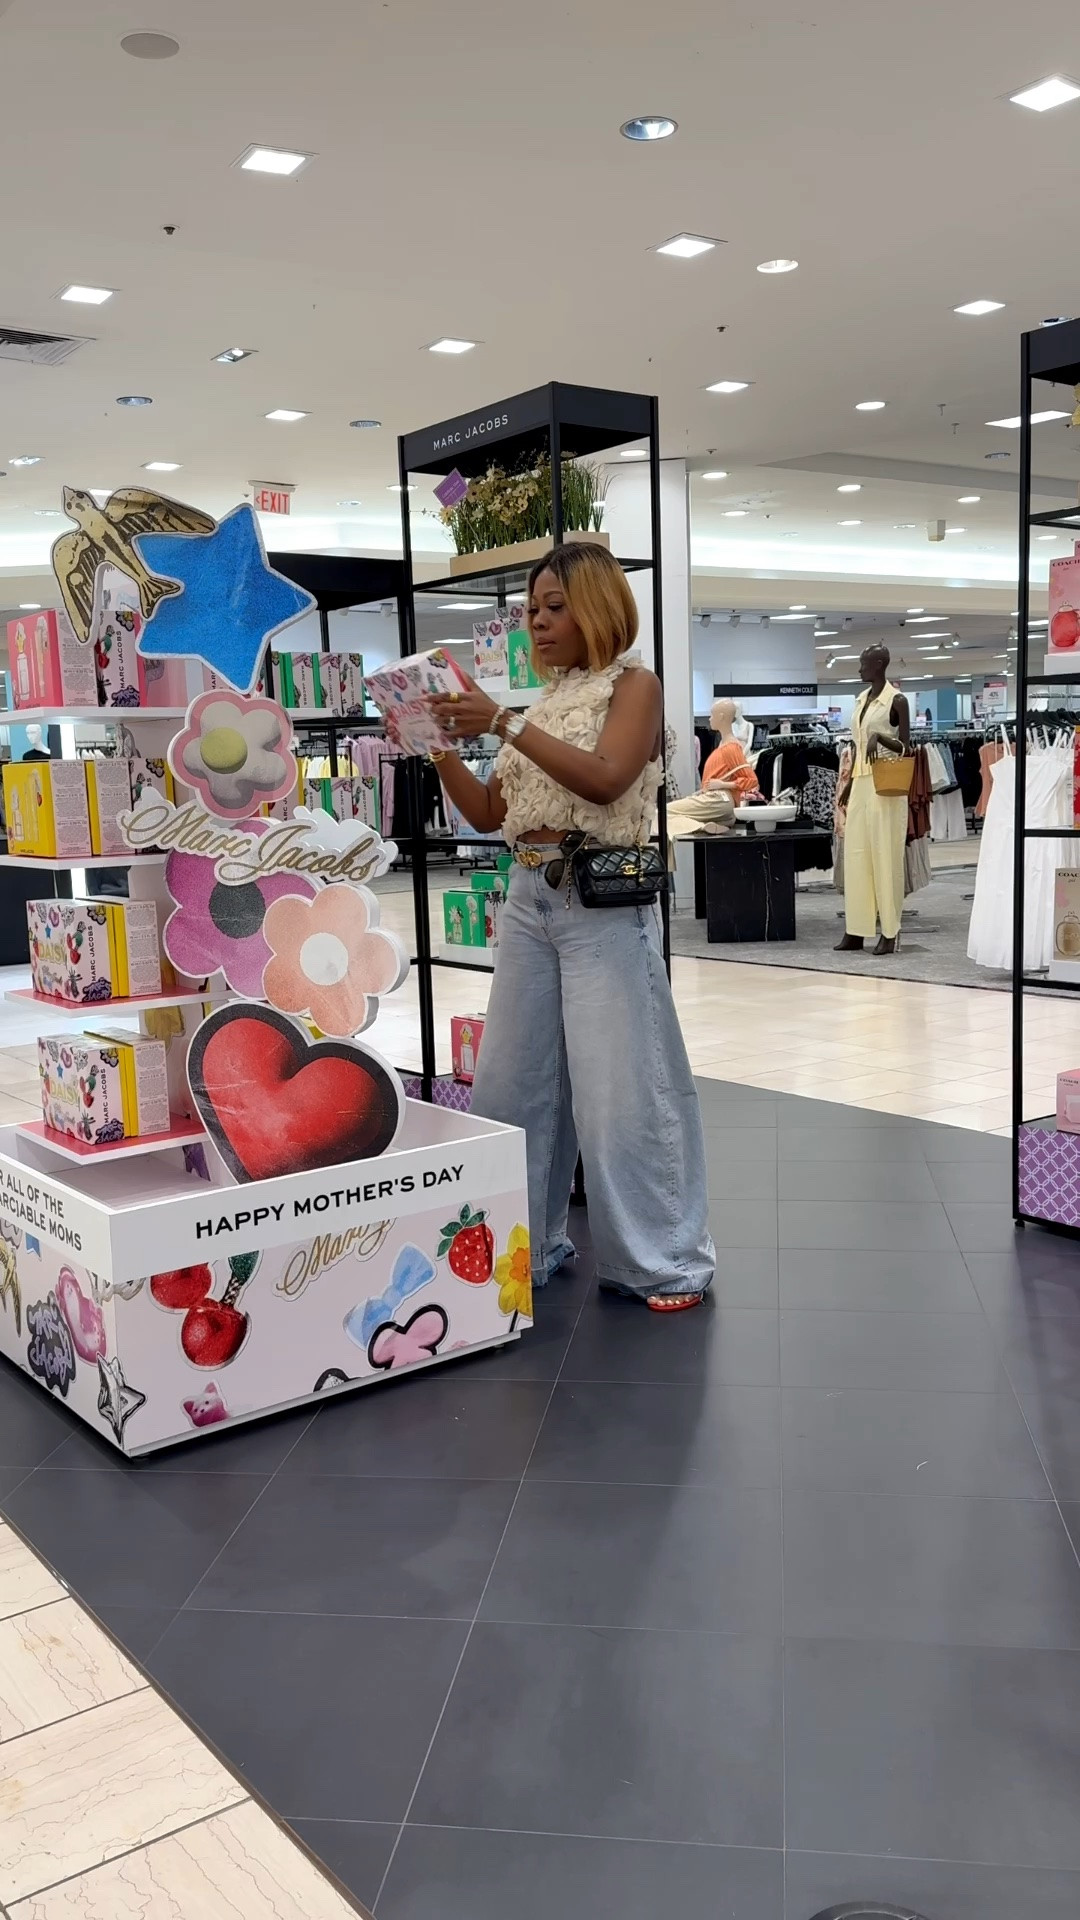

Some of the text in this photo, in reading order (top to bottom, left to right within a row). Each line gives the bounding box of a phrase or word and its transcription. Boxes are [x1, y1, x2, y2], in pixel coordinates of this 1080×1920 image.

[433, 414, 509, 451] MARC JACOBS
[261, 490, 289, 514] EXIT
[116, 630, 124, 663] JACOBS
[121, 805, 252, 858] Marc
[218, 824, 380, 881] Jacobs
[87, 925, 95, 958] JACOBS
[100, 1068, 108, 1100] JACOBS
[7, 1173, 24, 1197] ALL
[27, 1184, 40, 1204] OF
[43, 1192, 64, 1219] THE
[196, 1164, 464, 1239] HAPPY MOTHER'S DAY
[49, 1218, 82, 1251] MOMS
